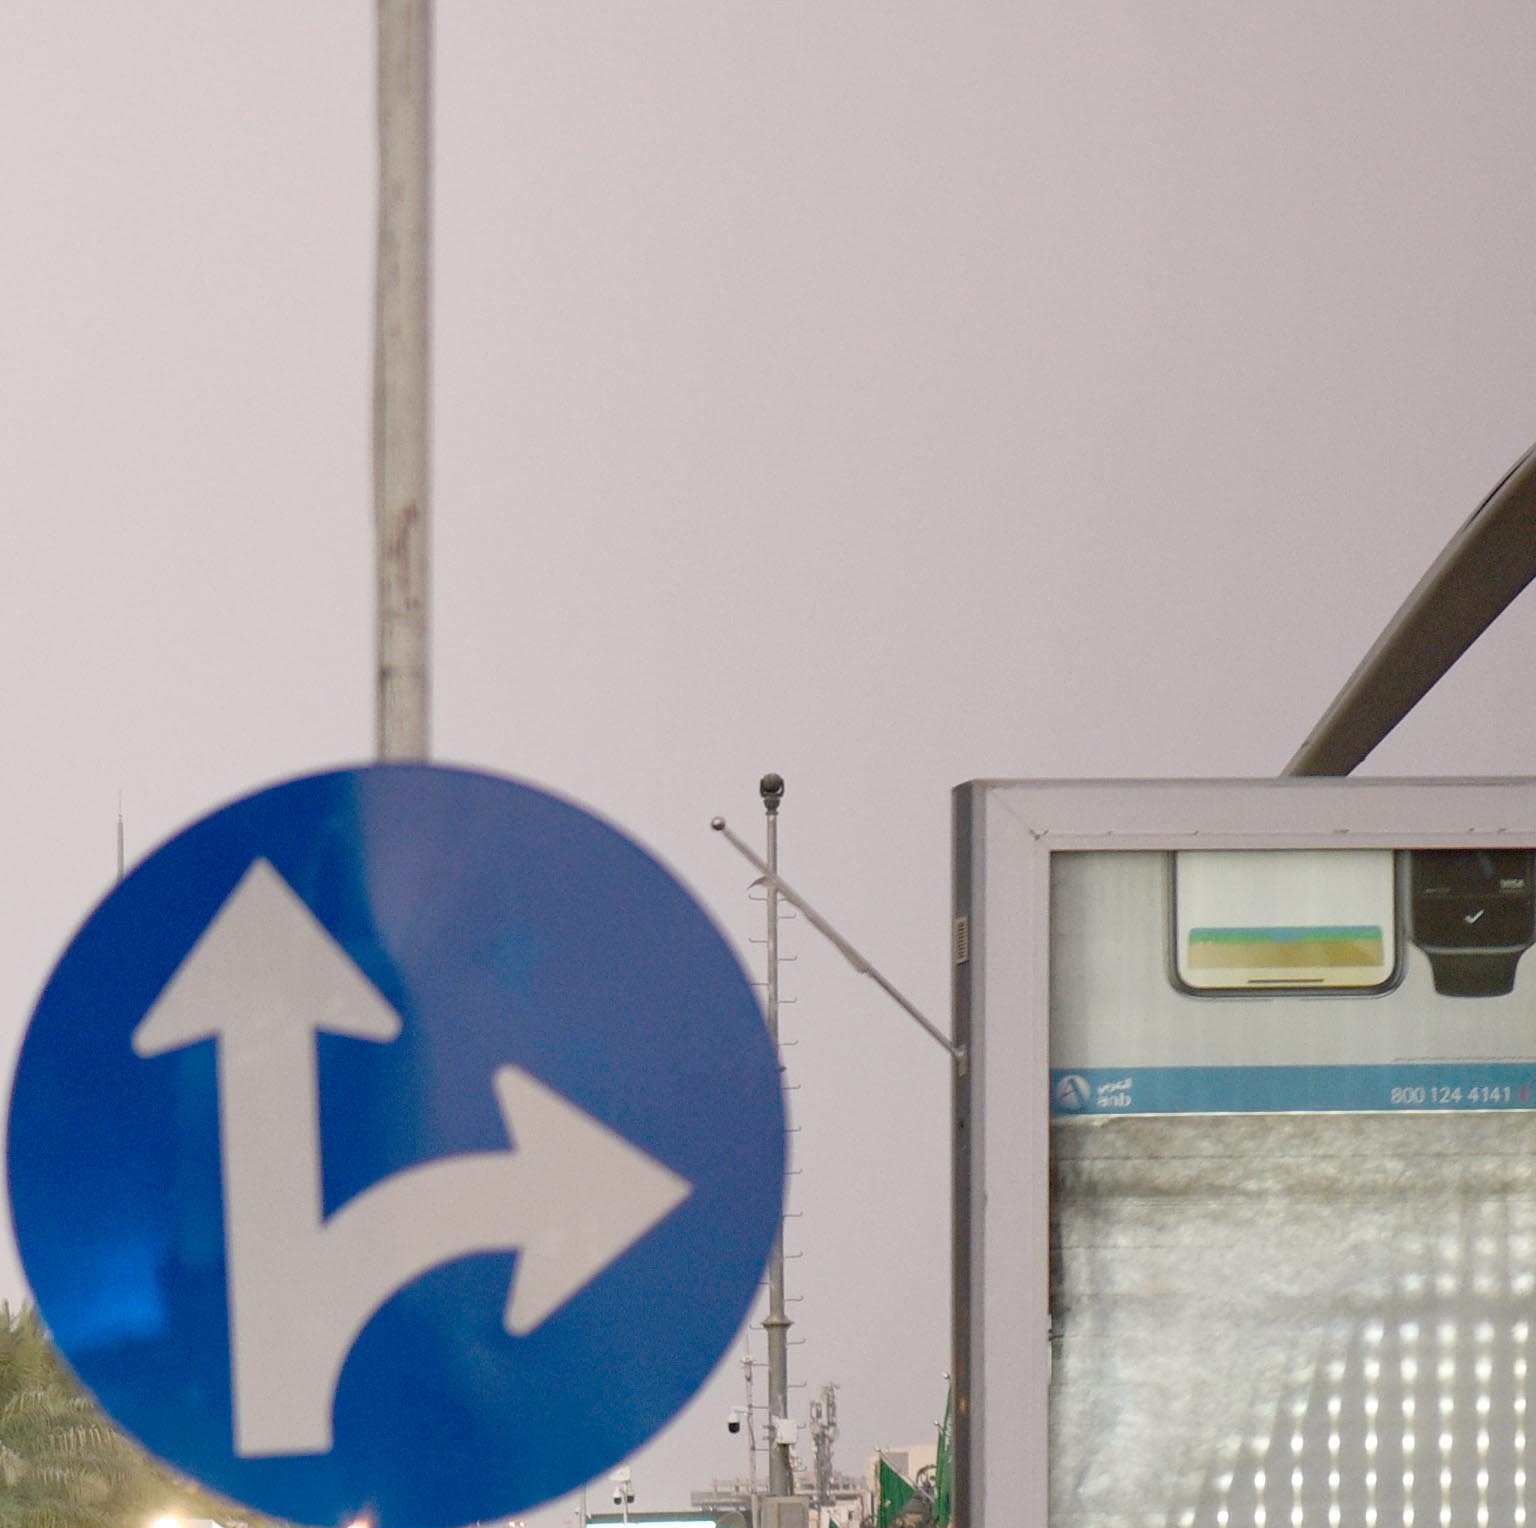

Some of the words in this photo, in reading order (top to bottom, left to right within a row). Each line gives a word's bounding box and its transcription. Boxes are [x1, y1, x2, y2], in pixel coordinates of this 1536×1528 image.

[1391, 1087, 1426, 1104] 800
[1431, 1087, 1462, 1104] 124
[1468, 1086, 1511, 1104] 4141
